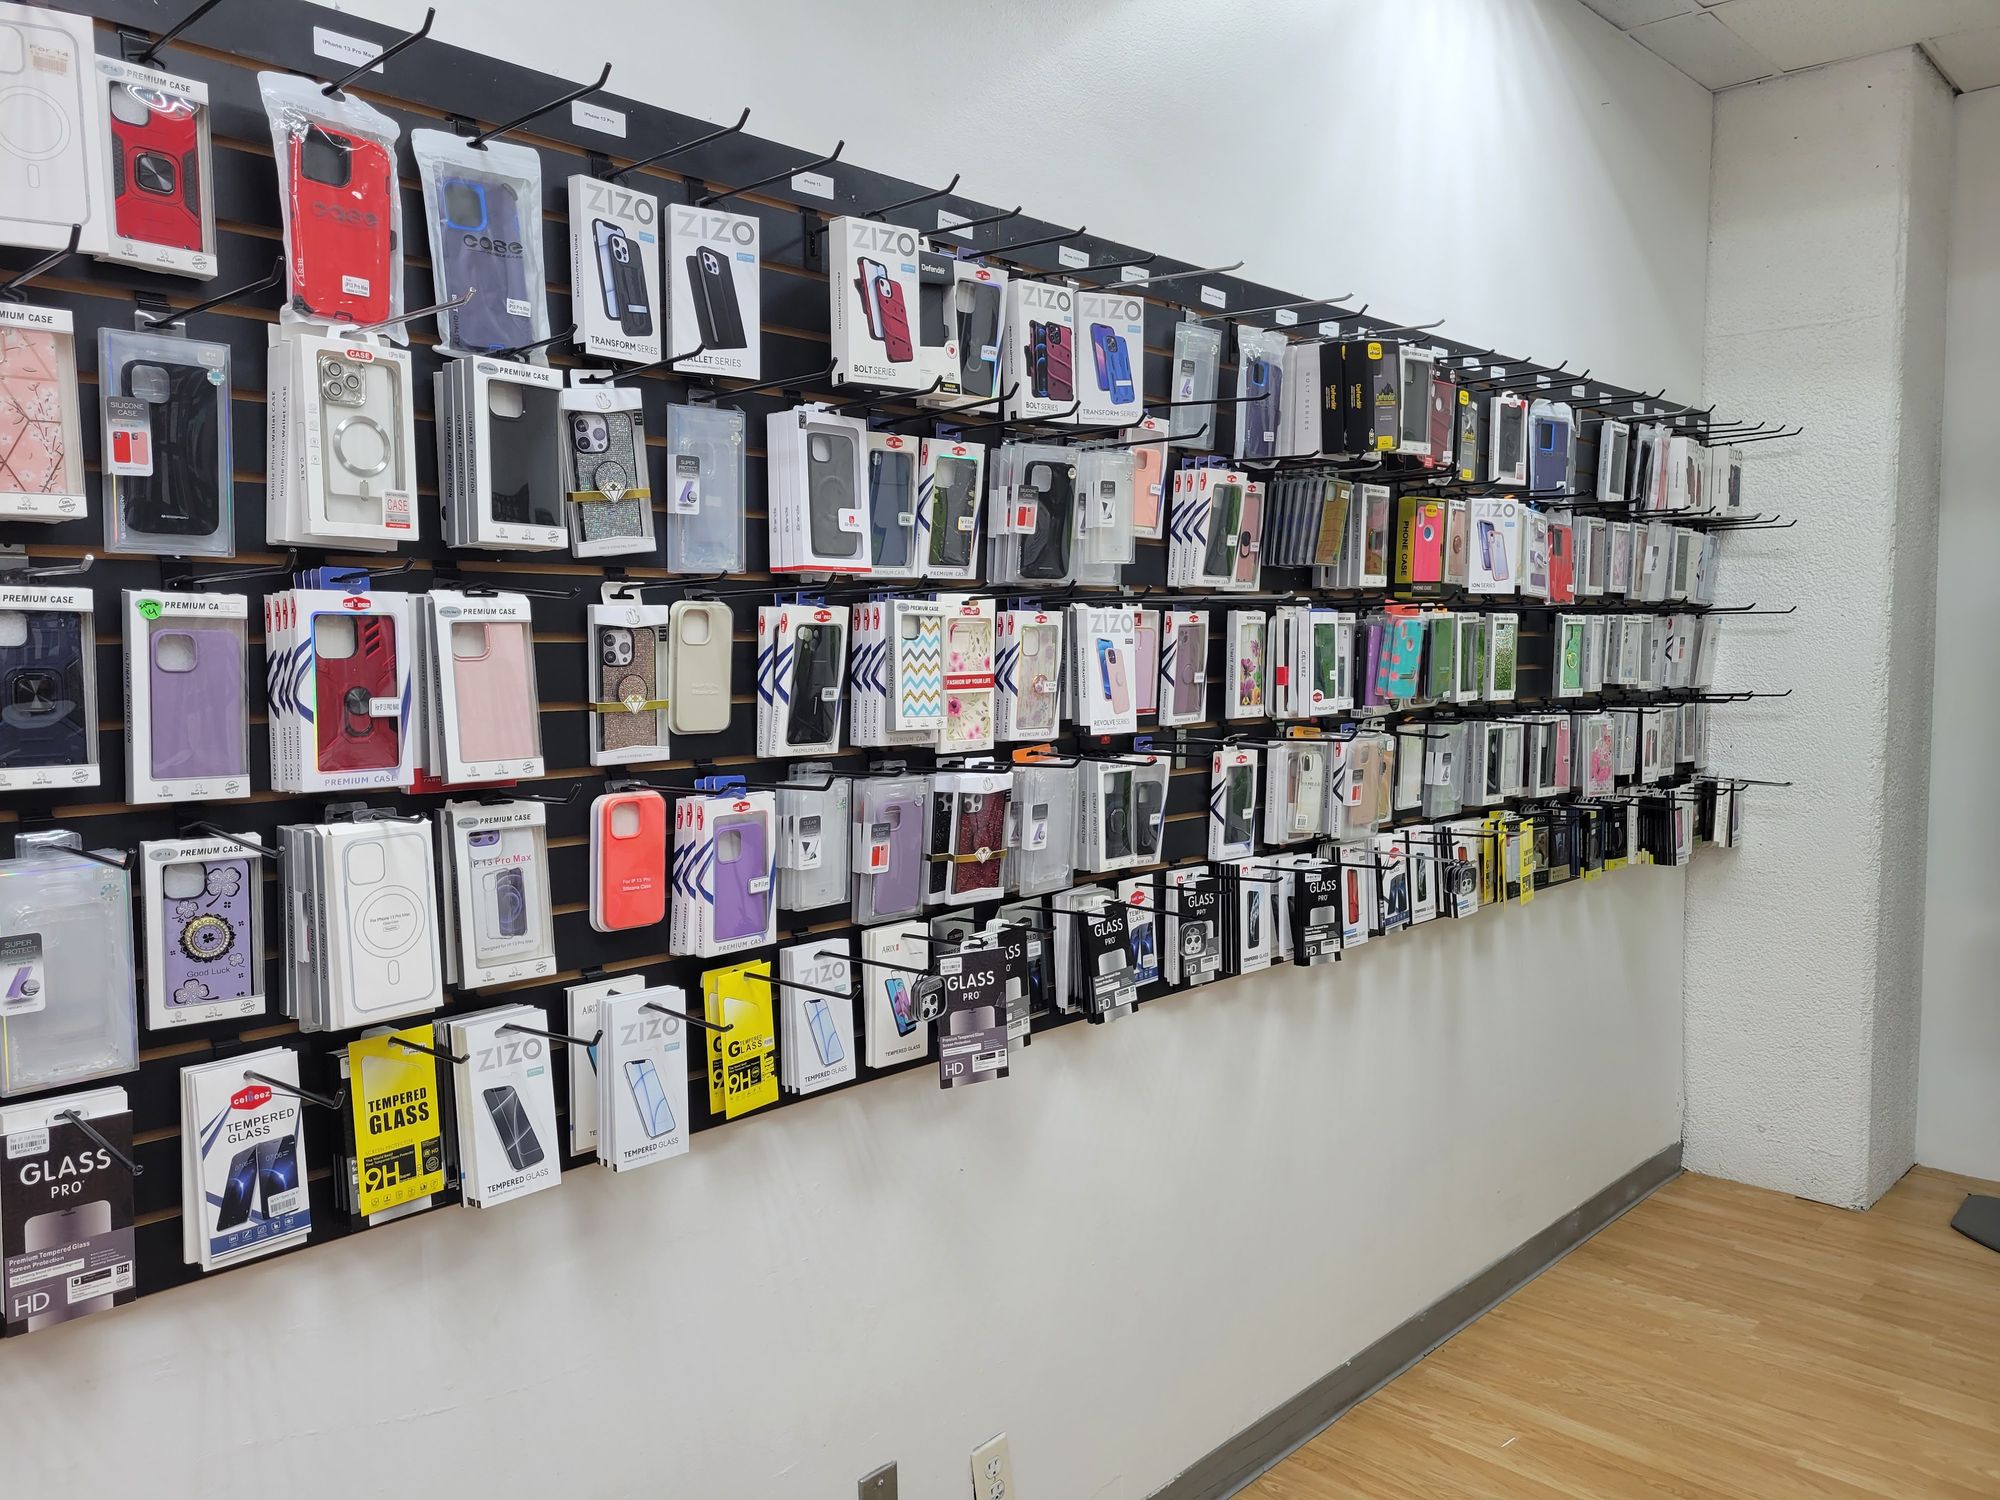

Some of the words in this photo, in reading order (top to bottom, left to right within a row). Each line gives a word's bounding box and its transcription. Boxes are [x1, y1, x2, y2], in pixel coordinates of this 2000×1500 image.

[322, 39, 342, 49] iPhone
[363, 50, 374, 58] Max
[126, 69, 167, 87] PREMIUM
[170, 81, 191, 92] CASE
[585, 183, 654, 225] ZIZO
[677, 211, 754, 246] ZIZO
[852, 224, 916, 256] ZIZO
[921, 263, 946, 276] Defender
[1023, 286, 1072, 312] ZIZO
[1083, 297, 1142, 321] ZIZO
[590, 336, 636, 351] TRANSFORM
[637, 344, 658, 356] SERIES
[350, 350, 370, 360] CASE
[715, 356, 742, 368] SERIES
[500, 367, 532, 378] PREMIUM
[533, 372, 550, 382] CASE
[854, 364, 872, 374] BOLT
[874, 366, 896, 377] SERIES
[110, 402, 144, 410] SILICONE
[1042, 404, 1058, 412] SERIES
[388, 499, 408, 512] CASE
[1475, 504, 1515, 517] ZIZO
[2, 594, 47, 604] PREMIUM
[50, 596, 74, 604] CASE
[463, 608, 497, 616] PREMIUM
[498, 608, 516, 616] CASE
[1090, 614, 1132, 634] ZIZO
[324, 776, 368, 786] PREMIUM
[480, 816, 512, 824] PREMIUM
[514, 814, 532, 822] CASE
[180, 847, 220, 857] PREMIUM
[222, 845, 244, 854] CASE
[495, 856, 510, 864] Pro
[514, 854, 532, 862] Max
[1310, 880, 1336, 894] GLASS
[1188, 893, 1214, 908] GLASS
[1094, 918, 1124, 938] GLASS
[4, 940, 32, 948] SUPER
[718, 941, 748, 952] PREMIUM
[750, 938, 765, 946] CASE
[1104, 937, 1116, 946] PRO
[1, 946, 38, 956] PROTECT
[1306, 946, 1316, 956] HD
[187, 969, 210, 978] Good
[212, 966, 230, 975] Luck
[800, 962, 845, 986] ZIZO
[1186, 964, 1196, 974] HD
[948, 970, 994, 991] GLASS
[963, 992, 980, 1001] PRO
[1098, 998, 1110, 1011] HD
[620, 1016, 680, 1046] ZIZO
[476, 1038, 542, 1073] ZIZO
[886, 1048, 906, 1058] TEMPERED
[907, 1044, 920, 1052] GLASS
[805, 1070, 830, 1083] TEMPERED
[831, 1065, 848, 1075] GLASS
[945, 1062, 964, 1077] HD
[729, 1068, 750, 1096] 9H
[368, 1087, 426, 1113] TEMPERED
[226, 1108, 295, 1133] TEMPERED
[370, 1102, 430, 1136] GLASS
[228, 1126, 271, 1144] GLASS
[624, 1144, 658, 1159] TEMPERED
[658, 1136, 678, 1150] GLASS
[20, 1148, 112, 1186] GLASS
[365, 1161, 400, 1194] 9H
[488, 1176, 524, 1194] TEMPERED
[526, 1168, 549, 1182] GLASS
[50, 1181, 82, 1198] PRO
[9, 1254, 38, 1266] Premium
[40, 1246, 72, 1258] Tempered
[72, 1240, 90, 1250] Glass
[9, 1264, 32, 1274] Screen
[32, 1256, 64, 1268] Protection
[117, 1264, 130, 1274] 9H
[14, 1292, 50, 1317] HD
